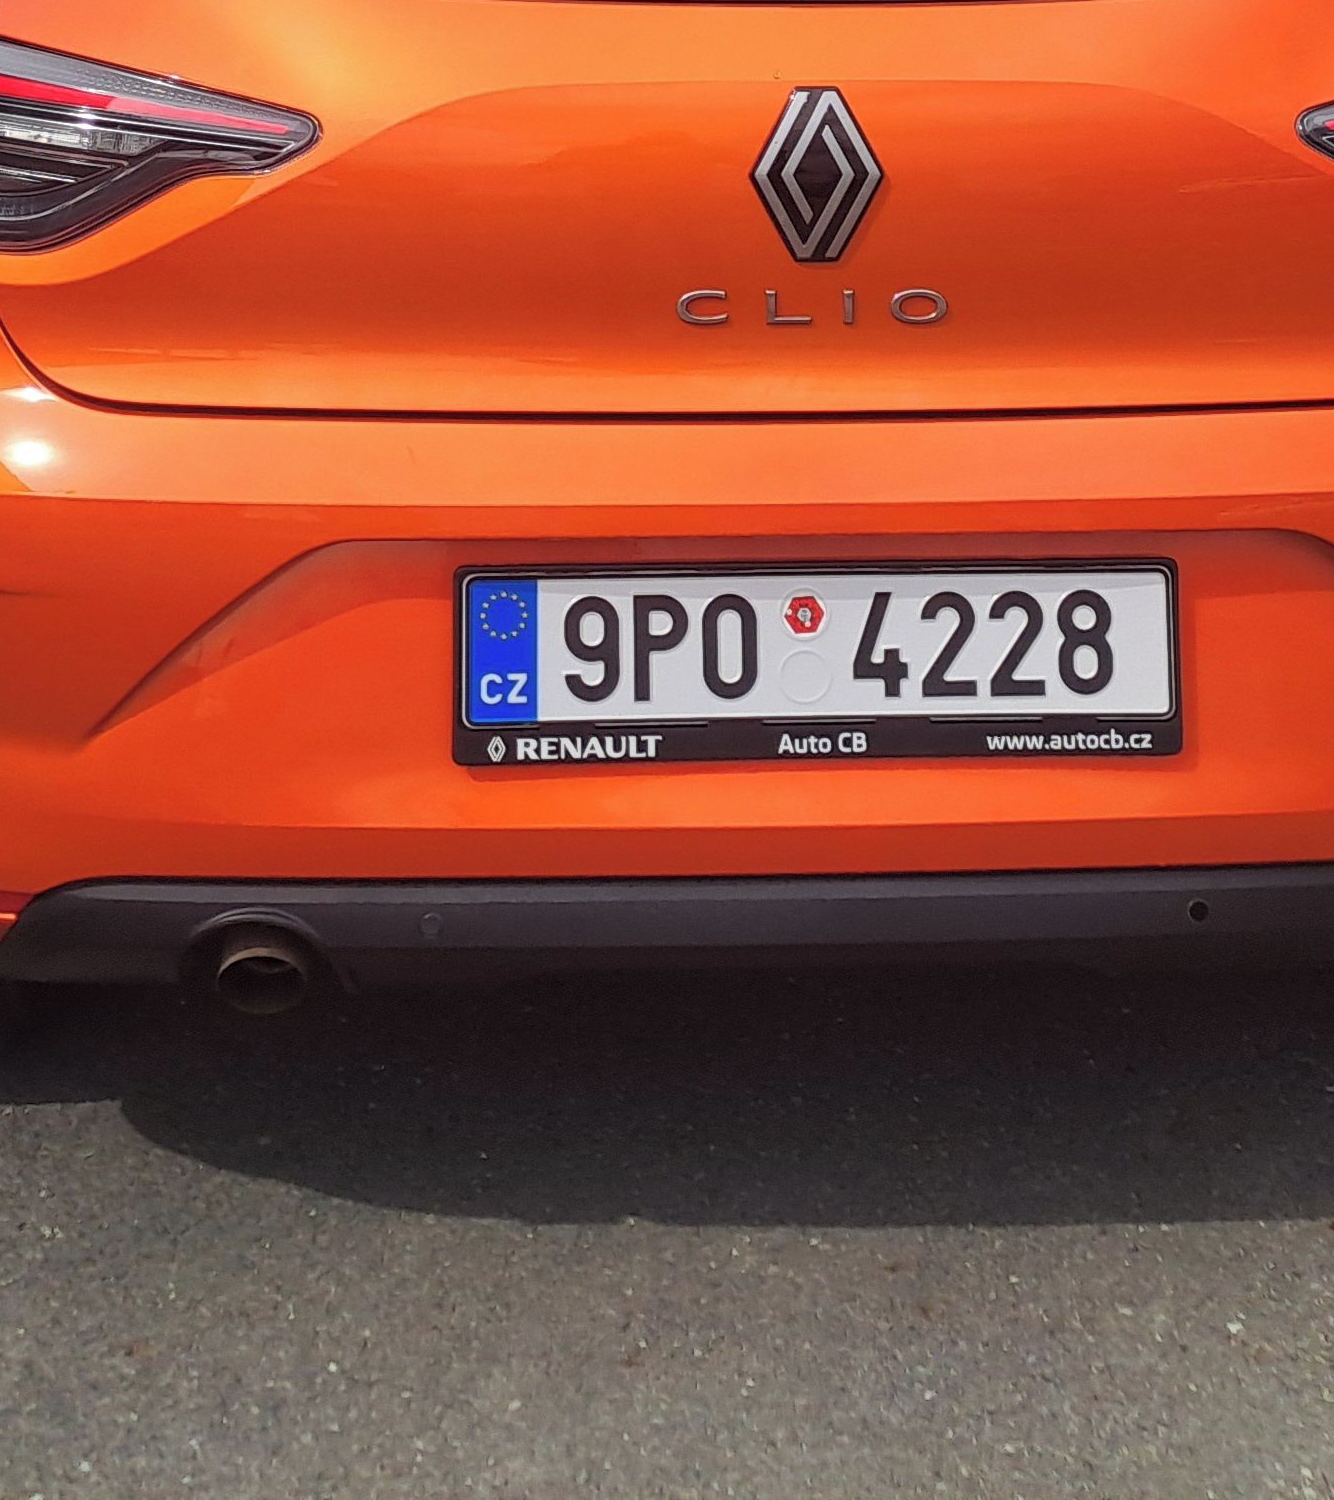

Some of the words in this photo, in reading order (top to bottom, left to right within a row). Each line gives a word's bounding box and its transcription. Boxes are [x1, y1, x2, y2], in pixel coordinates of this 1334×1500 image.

[676, 289, 948, 325] CLIO
[479, 673, 528, 705] CZ
[564, 594, 758, 702] 9P0
[853, 589, 1114, 698] 4228
[517, 735, 663, 761] RENAULT
[777, 734, 832, 755] Auto
[838, 732, 867, 752] CB
[986, 729, 1153, 751] www.autocb.cz
